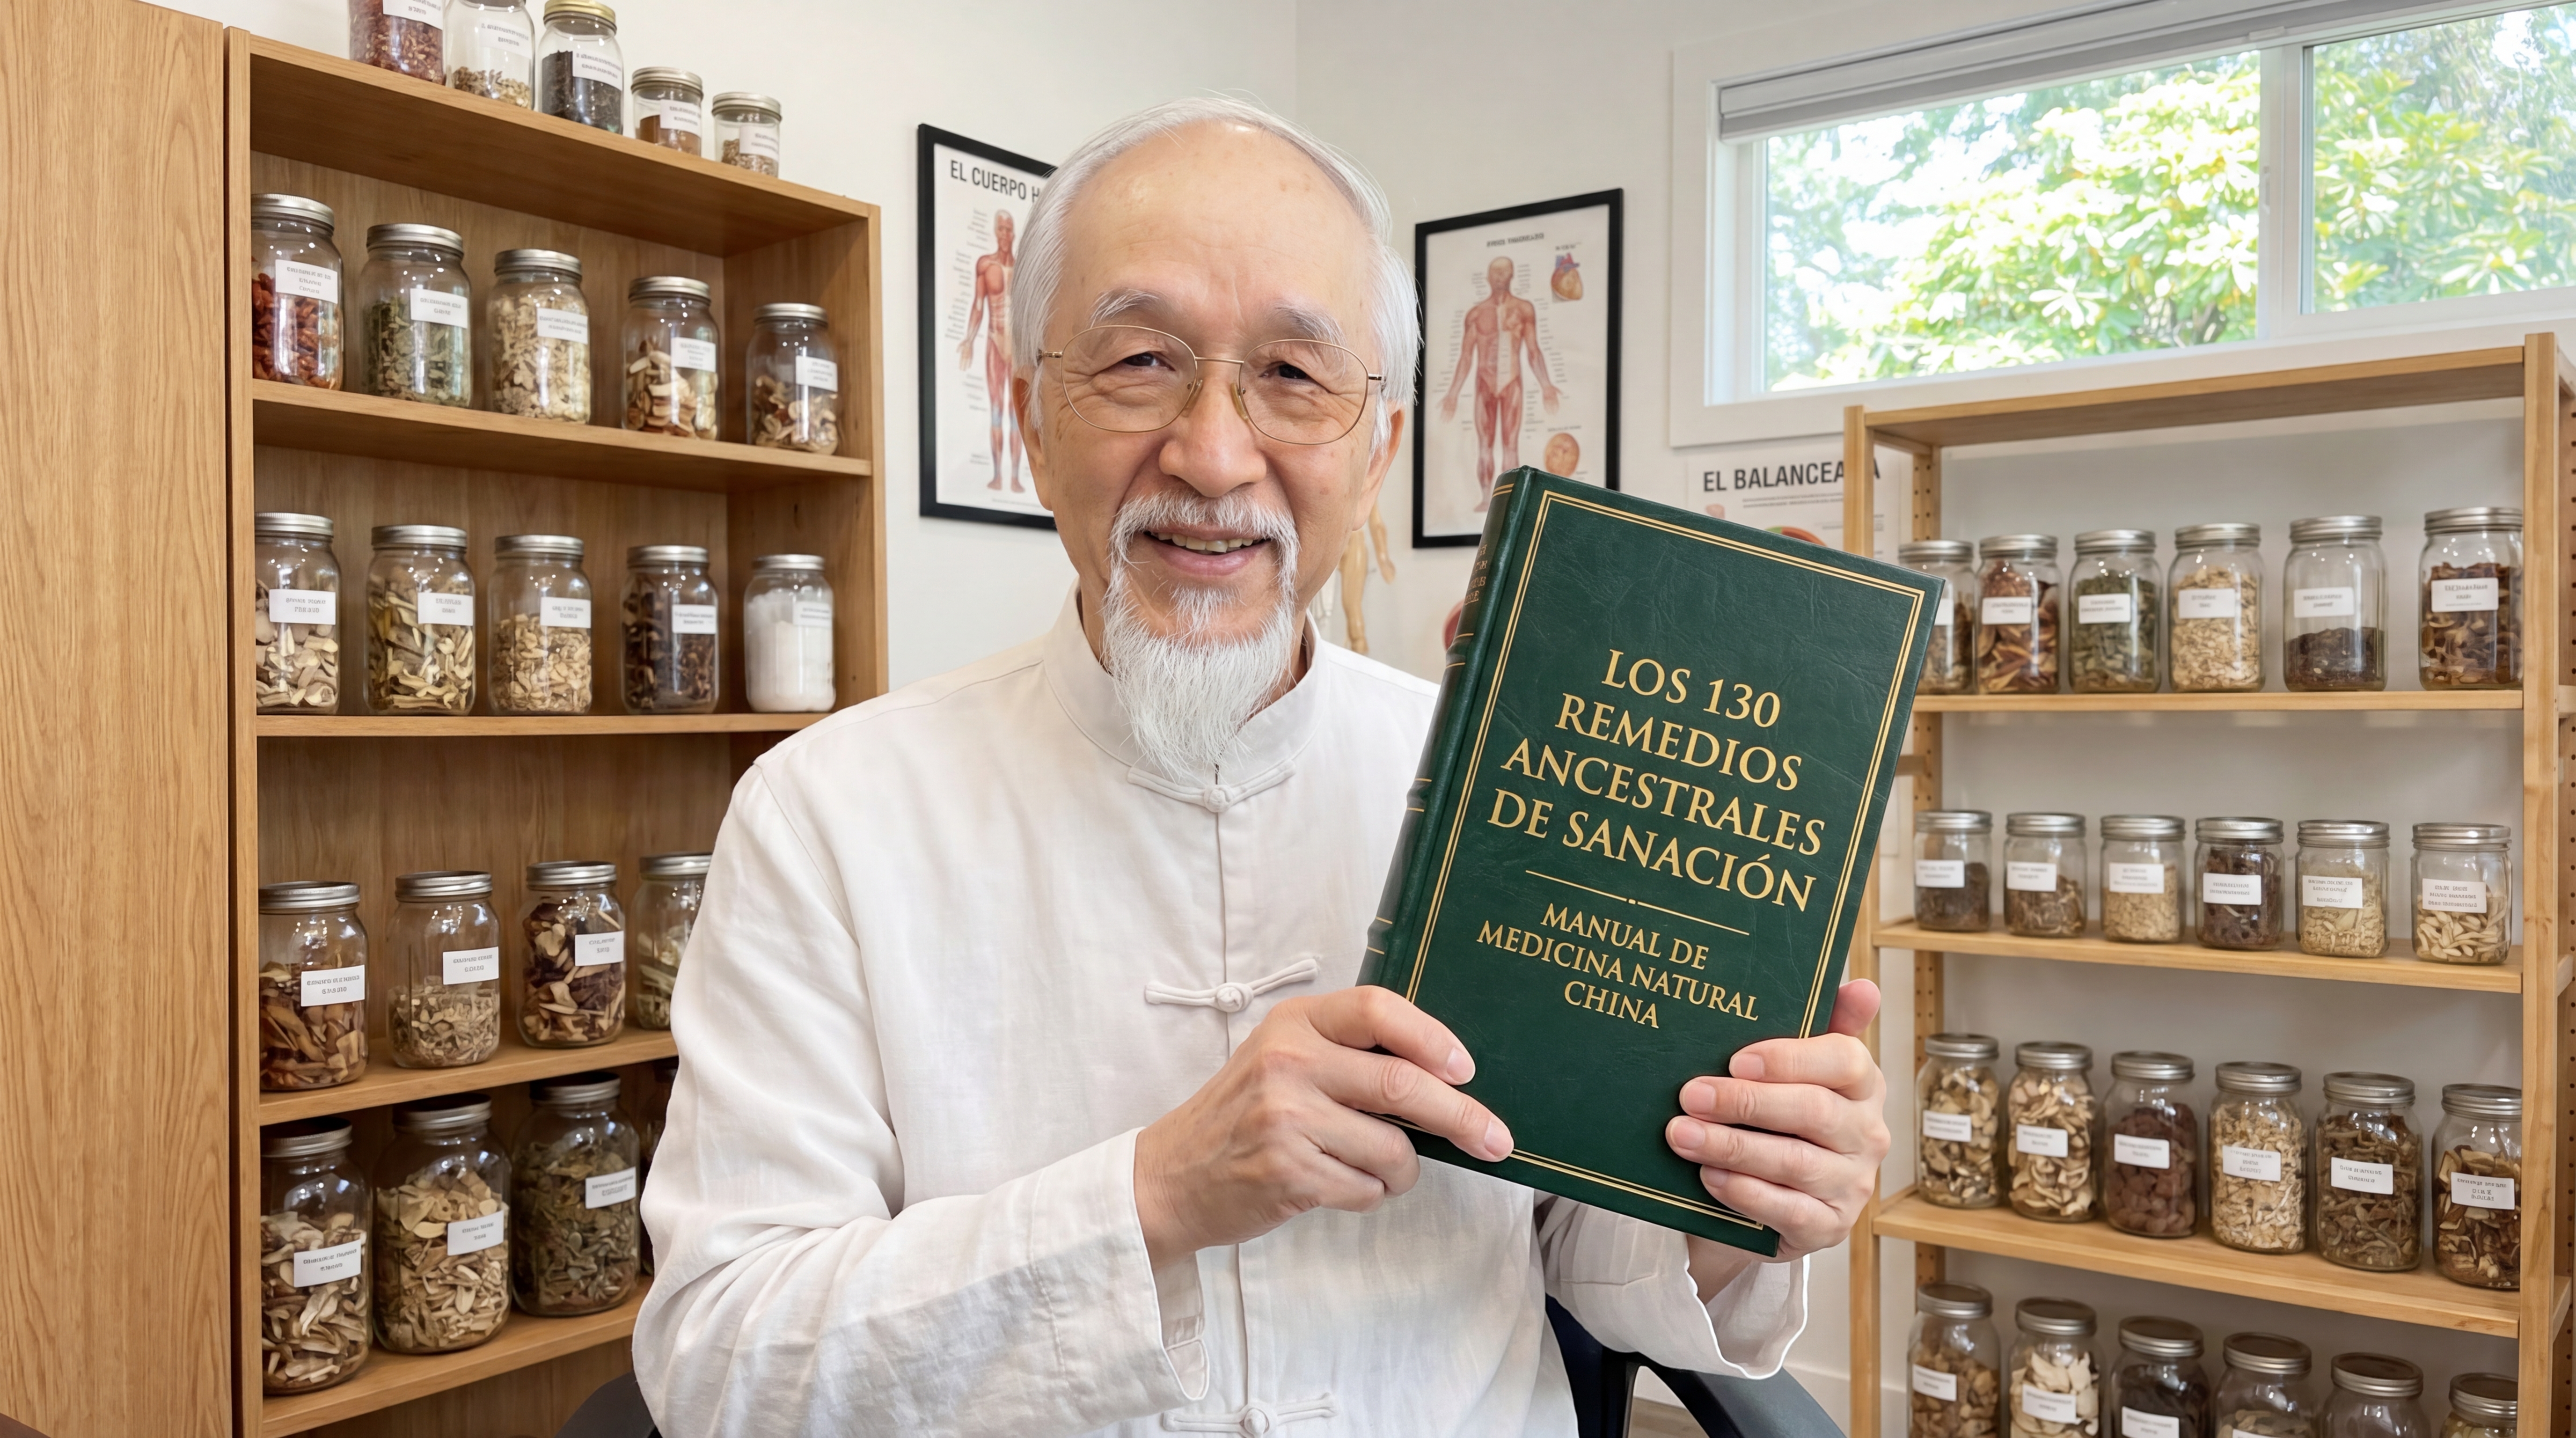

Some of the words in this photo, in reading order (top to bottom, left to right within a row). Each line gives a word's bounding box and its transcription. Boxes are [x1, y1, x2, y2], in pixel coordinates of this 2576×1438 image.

[950, 160, 967, 182] EL
[972, 167, 1026, 200] CUERPO
[1703, 471, 1727, 492] EL
[1734, 457, 1881, 490] BALANCEA
[1601, 649, 1691, 704] LOS
[1703, 678, 1781, 728] 130
[1555, 693, 1802, 791] REMEDIOS
[1500, 738, 1826, 856] ANCESTRALES
[1487, 788, 1554, 839] DE
[1562, 810, 1817, 912] SANACIÓN
[1477, 920, 1624, 983] MEDICINA
[1629, 963, 1758, 1021] NATURAL
[1540, 903, 1661, 958] MANUAL
[1669, 938, 1709, 970] DE
[1564, 981, 1659, 1029] CHINA
